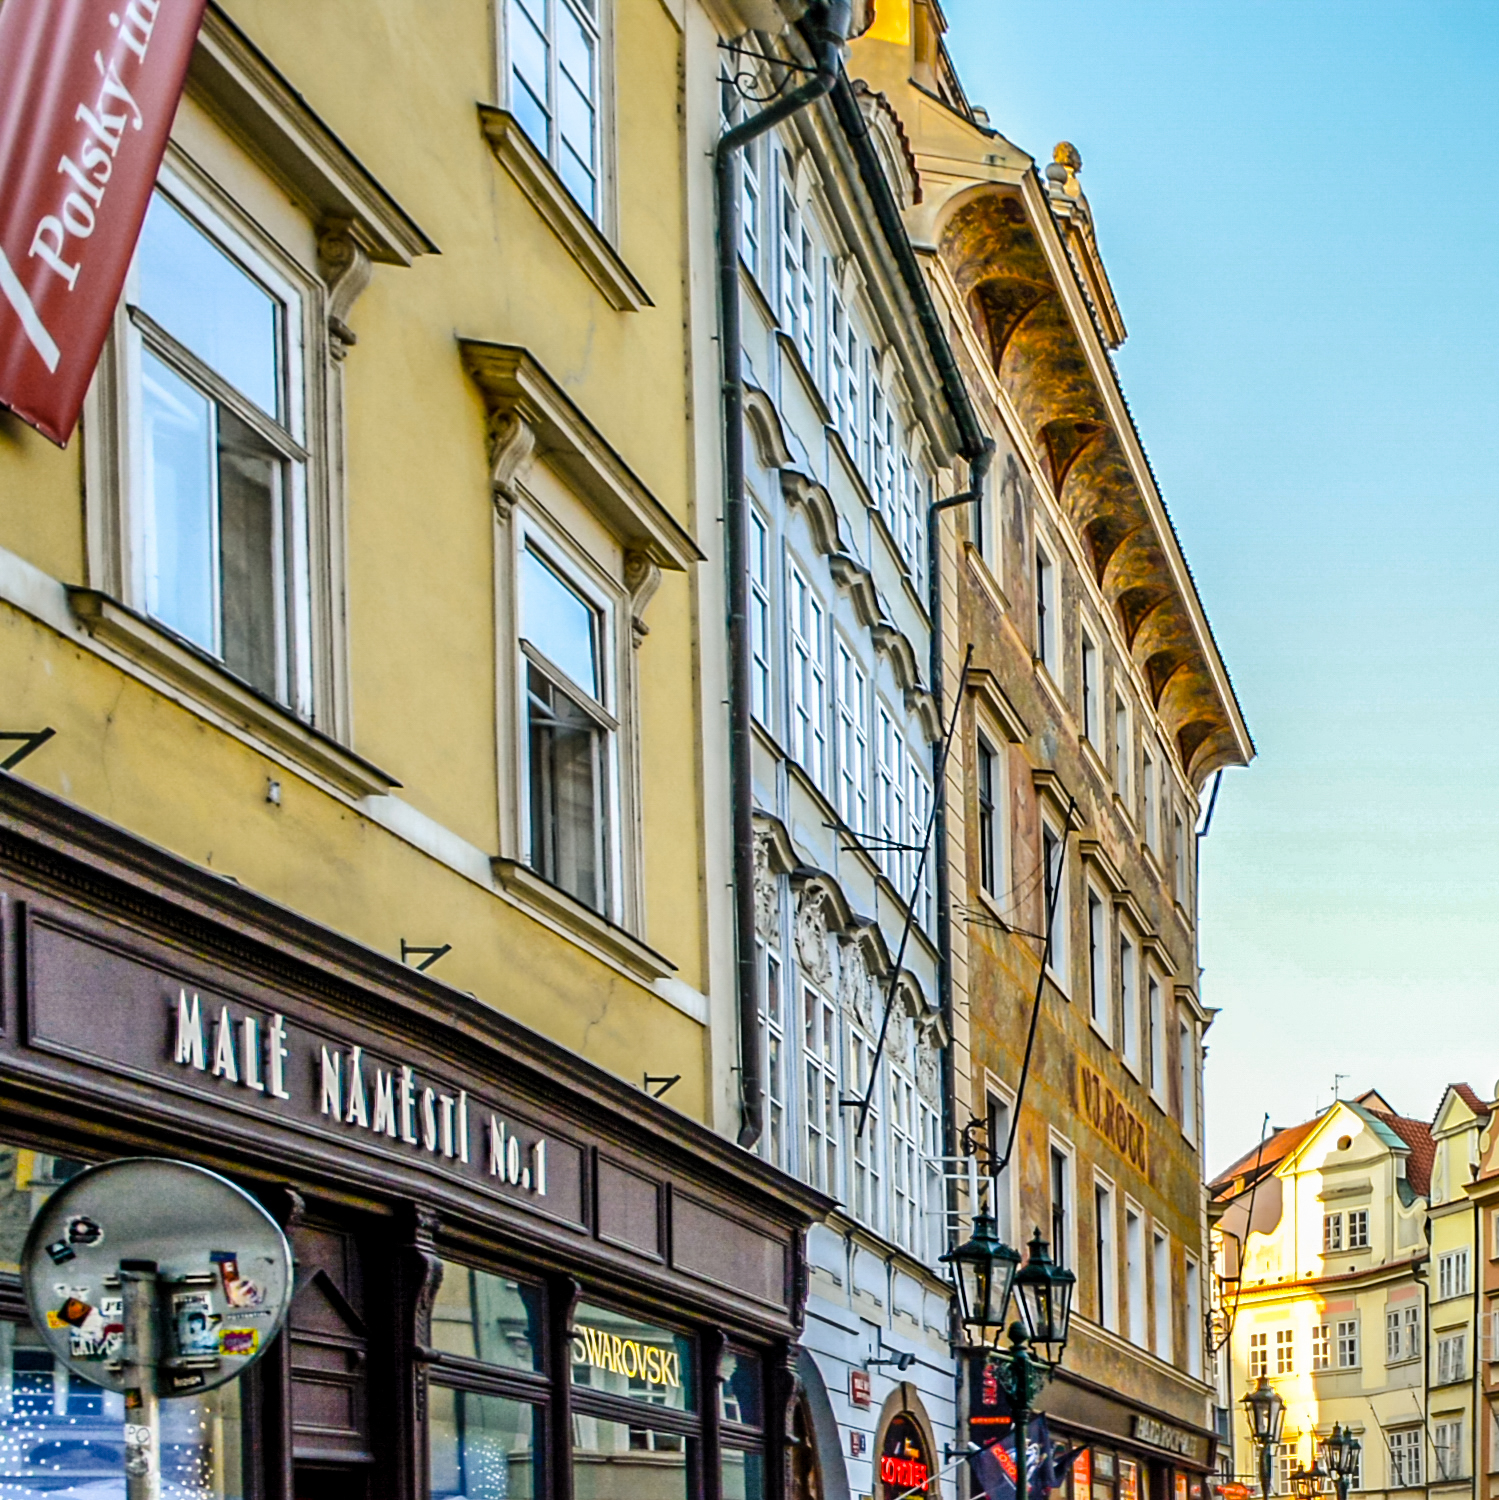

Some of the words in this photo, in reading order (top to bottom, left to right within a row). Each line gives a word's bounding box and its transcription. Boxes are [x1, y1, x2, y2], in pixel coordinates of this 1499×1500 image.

[28, 49, 143, 292] Polský
[174, 988, 290, 1100] MALÉ
[320, 1044, 469, 1164] NÁMĚSTÍ
[572, 1324, 680, 1388] SWAROVSKI
